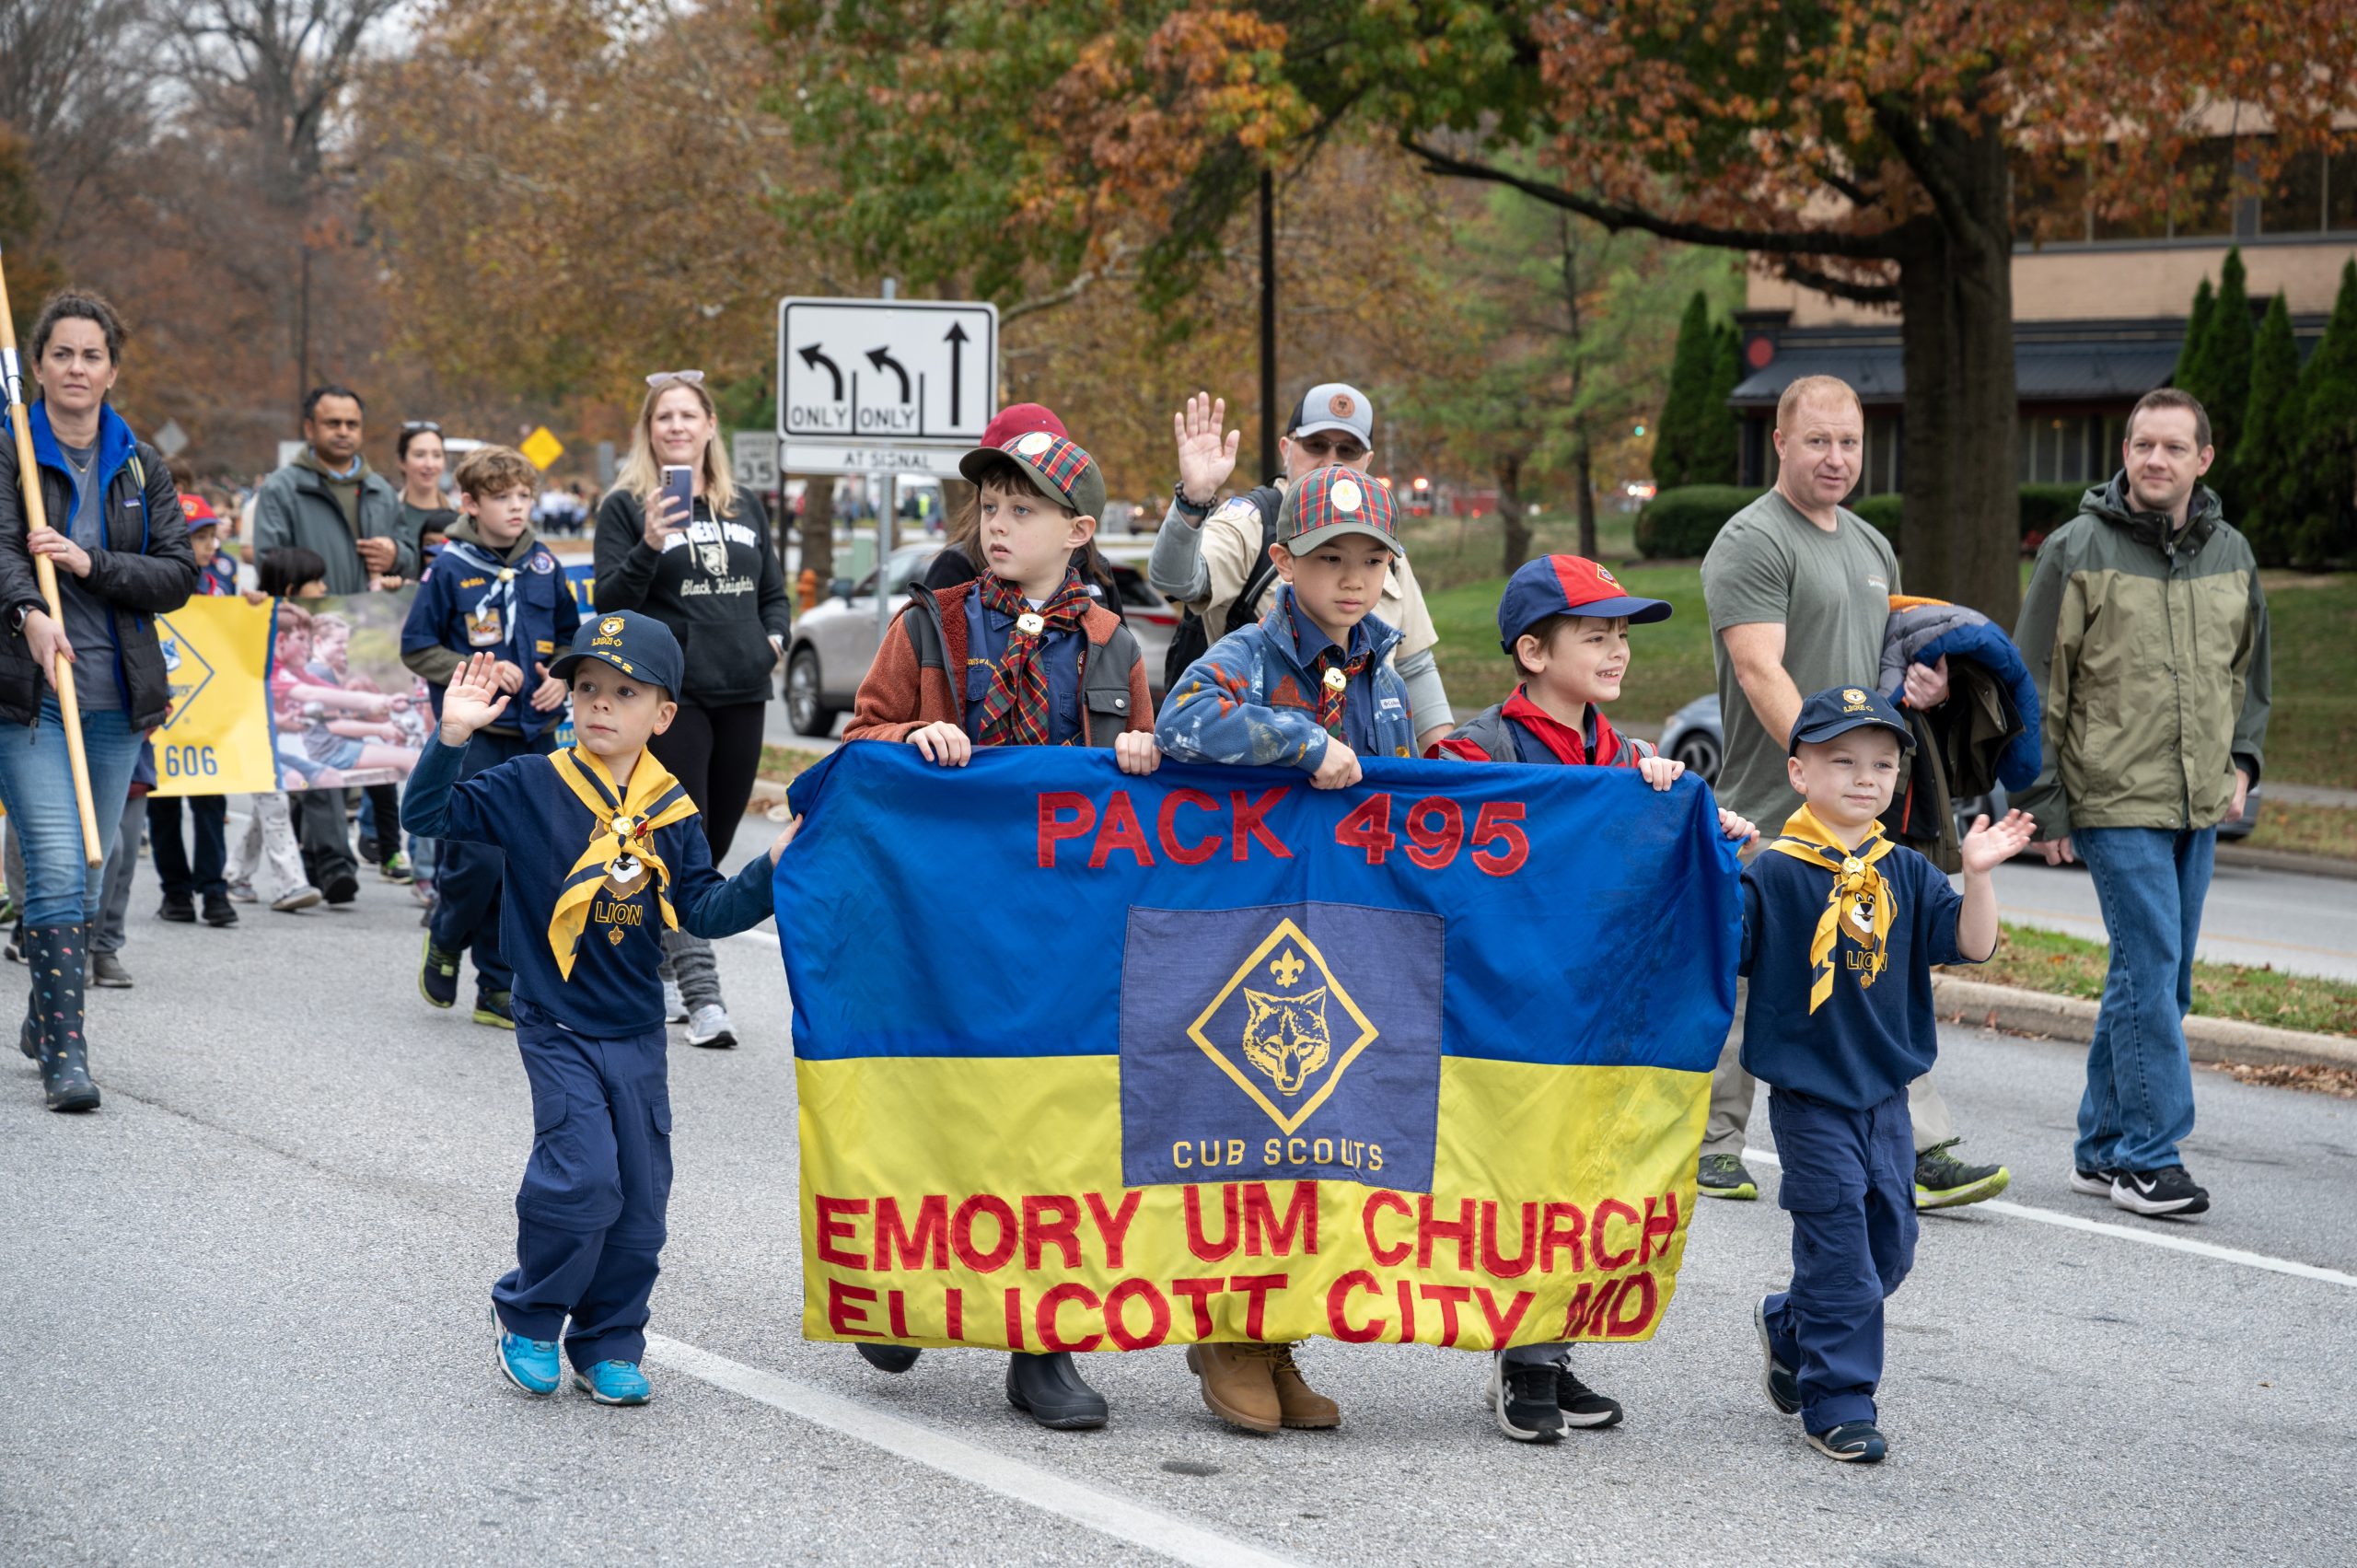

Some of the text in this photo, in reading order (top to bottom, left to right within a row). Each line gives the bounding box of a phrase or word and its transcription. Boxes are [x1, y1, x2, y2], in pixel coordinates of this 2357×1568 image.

[791, 406, 848, 426] ONLY
[858, 408, 915, 428] ONLY
[844, 452, 864, 466] AT
[871, 452, 932, 470] SIGNAL
[737, 460, 773, 483] 35
[680, 575, 754, 597] Black Knights
[591, 636, 613, 646] LION
[165, 745, 217, 776] 606
[1037, 785, 1530, 877] PACK 495
[595, 901, 643, 925] LION
[1172, 1138, 1384, 1171] CUB SCOUTS
[816, 1179, 1679, 1279] EMORY UM CHURCH
[1326, 1269, 1537, 1351] CITY
[1556, 1270, 1658, 1342] MD
